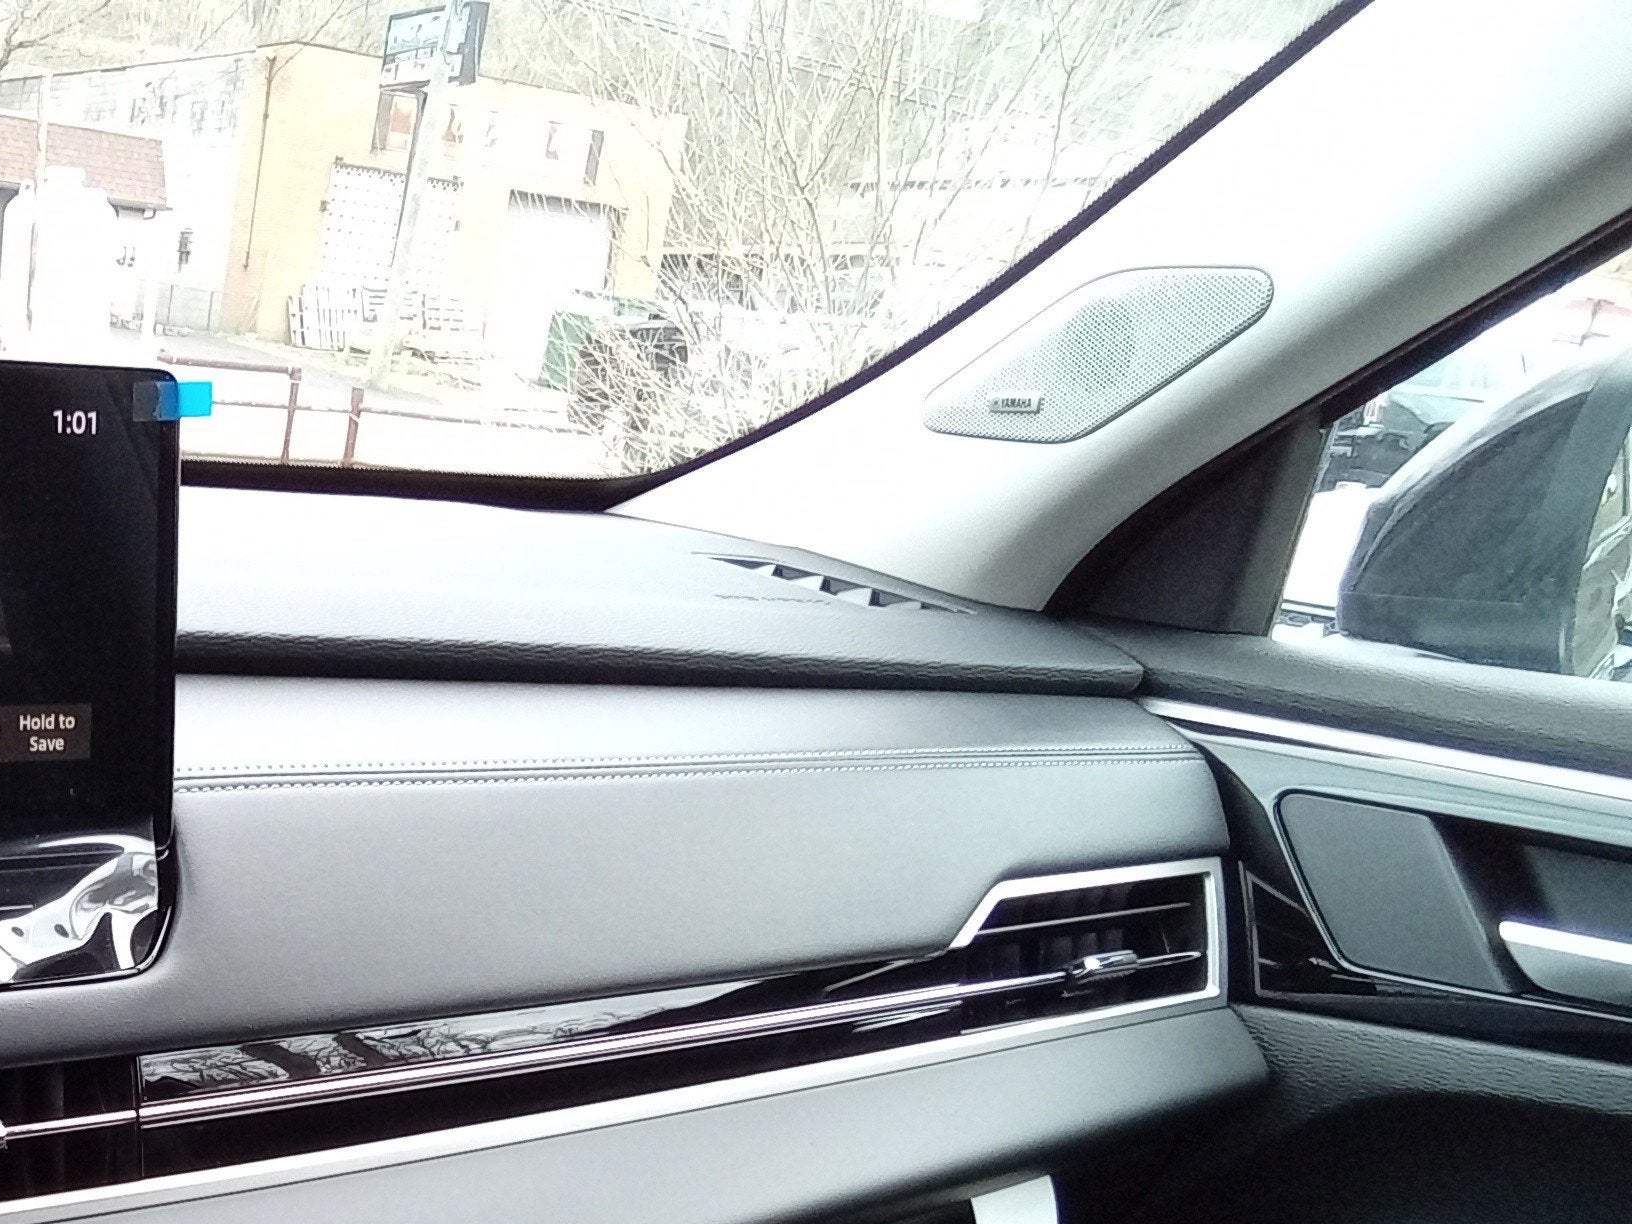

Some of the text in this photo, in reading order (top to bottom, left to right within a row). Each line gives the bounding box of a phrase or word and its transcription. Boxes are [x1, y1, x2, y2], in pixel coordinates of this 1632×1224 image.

[52, 409, 98, 435] 1:01
[19, 714, 54, 732] Hold
[57, 715, 75, 730] to
[29, 736, 64, 752] Save
